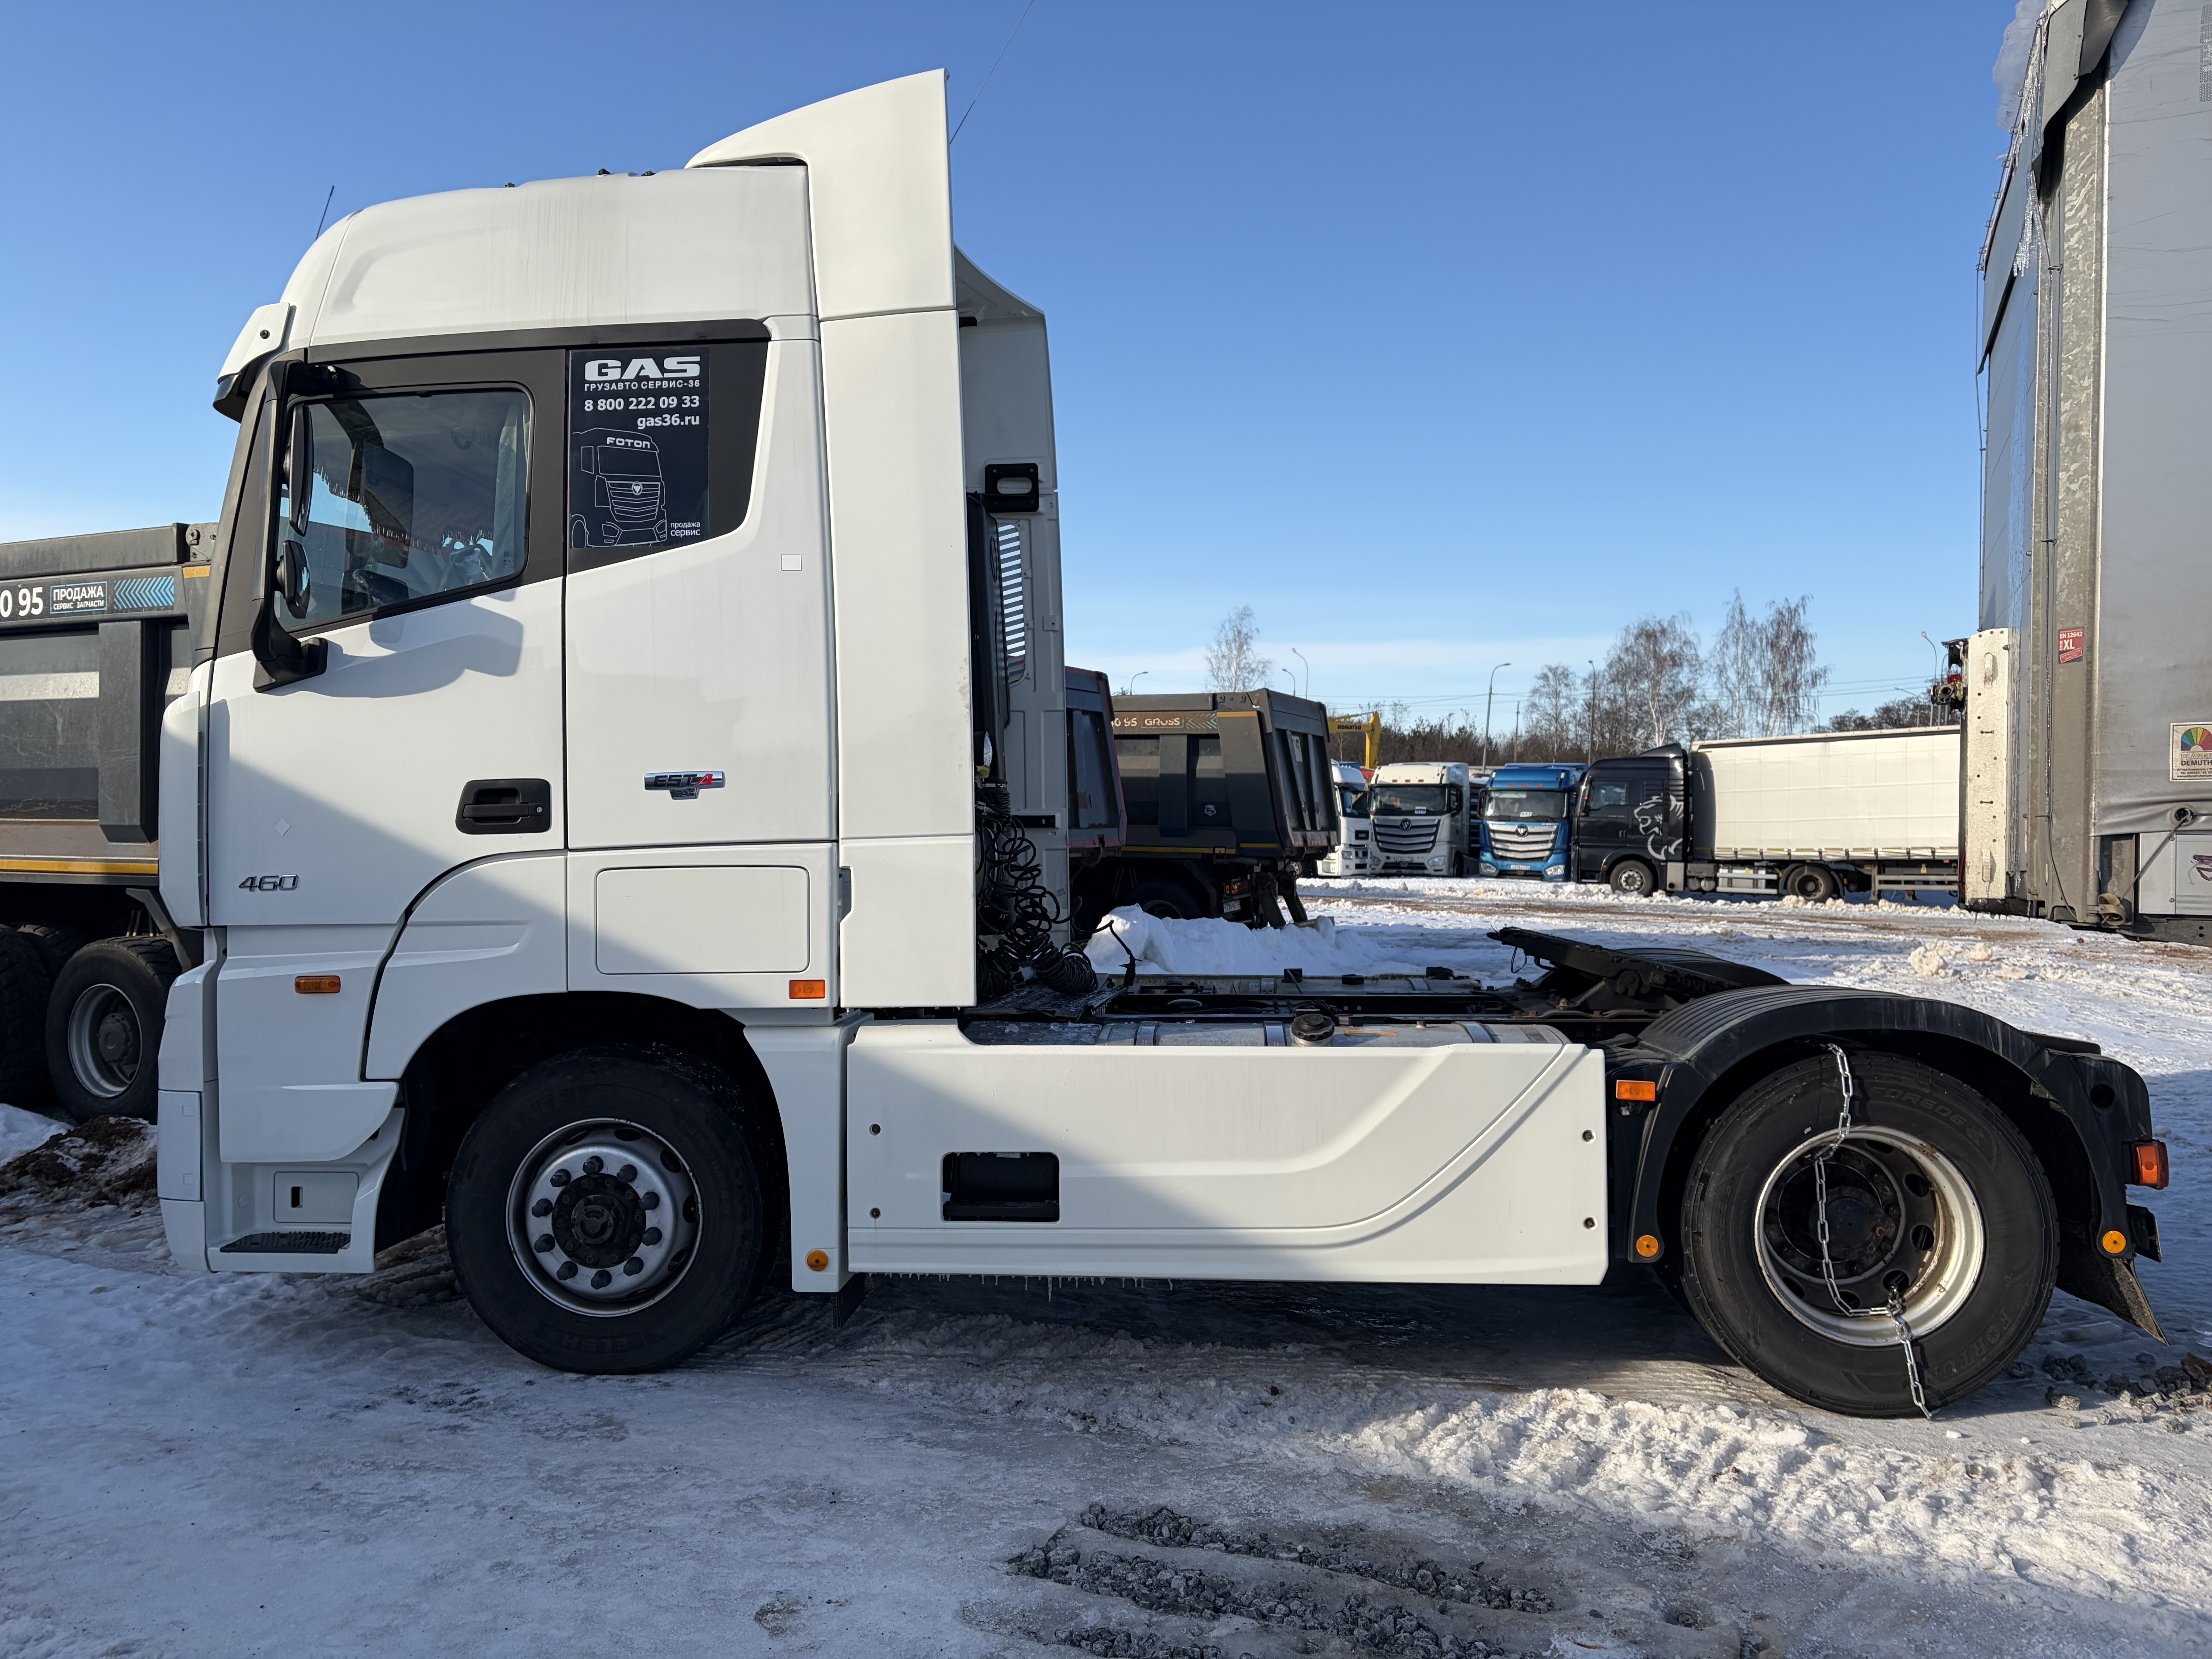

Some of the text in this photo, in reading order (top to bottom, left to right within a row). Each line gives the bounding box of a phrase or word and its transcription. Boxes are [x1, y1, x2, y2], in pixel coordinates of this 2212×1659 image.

[585, 356, 700, 381] GAS
[584, 380, 700, 392] ГРУЗАВТО СЕРВИС-36
[584, 395, 700, 411] 8 800 222 09 33
[637, 414, 700, 429] gas36.ru
[670, 529, 701, 538] сервис
[53, 586, 104, 601] ПРОДАЖА
[0, 587, 43, 618] 0 95
[53, 600, 104, 610] СЕРВИС ЗАПЧАСТИ
[2063, 639, 2075, 650] XL
[239, 874, 299, 892] 460
